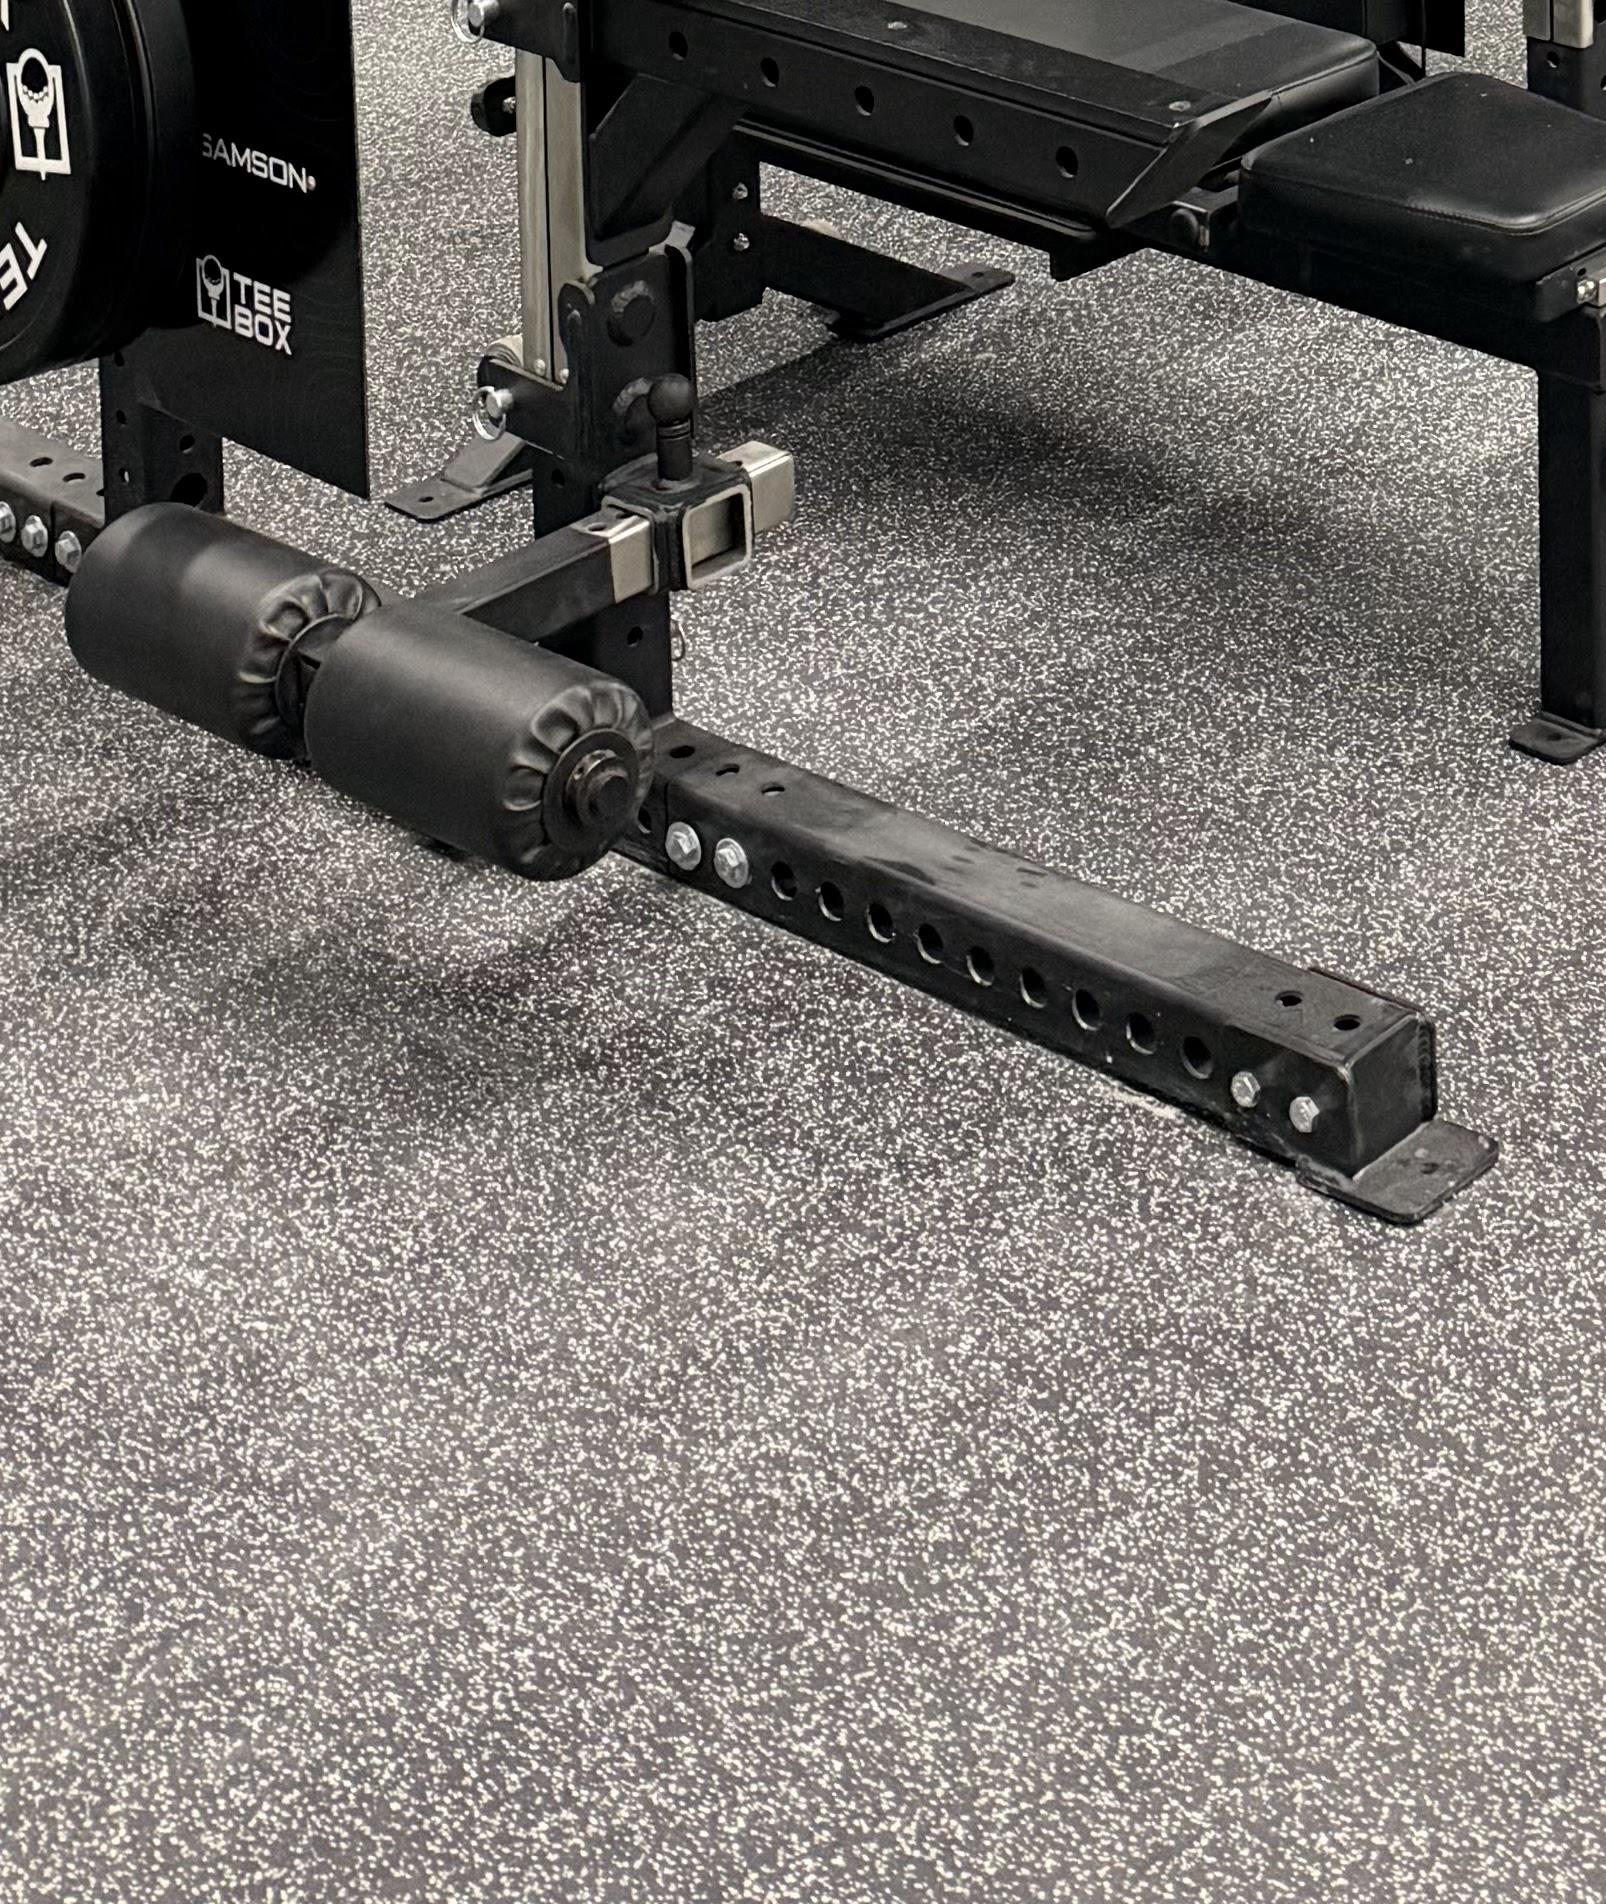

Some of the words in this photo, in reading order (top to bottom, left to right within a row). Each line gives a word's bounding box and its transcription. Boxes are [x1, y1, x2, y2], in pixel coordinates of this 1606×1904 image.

[202, 132, 308, 194] SAMSON
[233, 271, 292, 324] TEE
[234, 303, 293, 356] BOX
